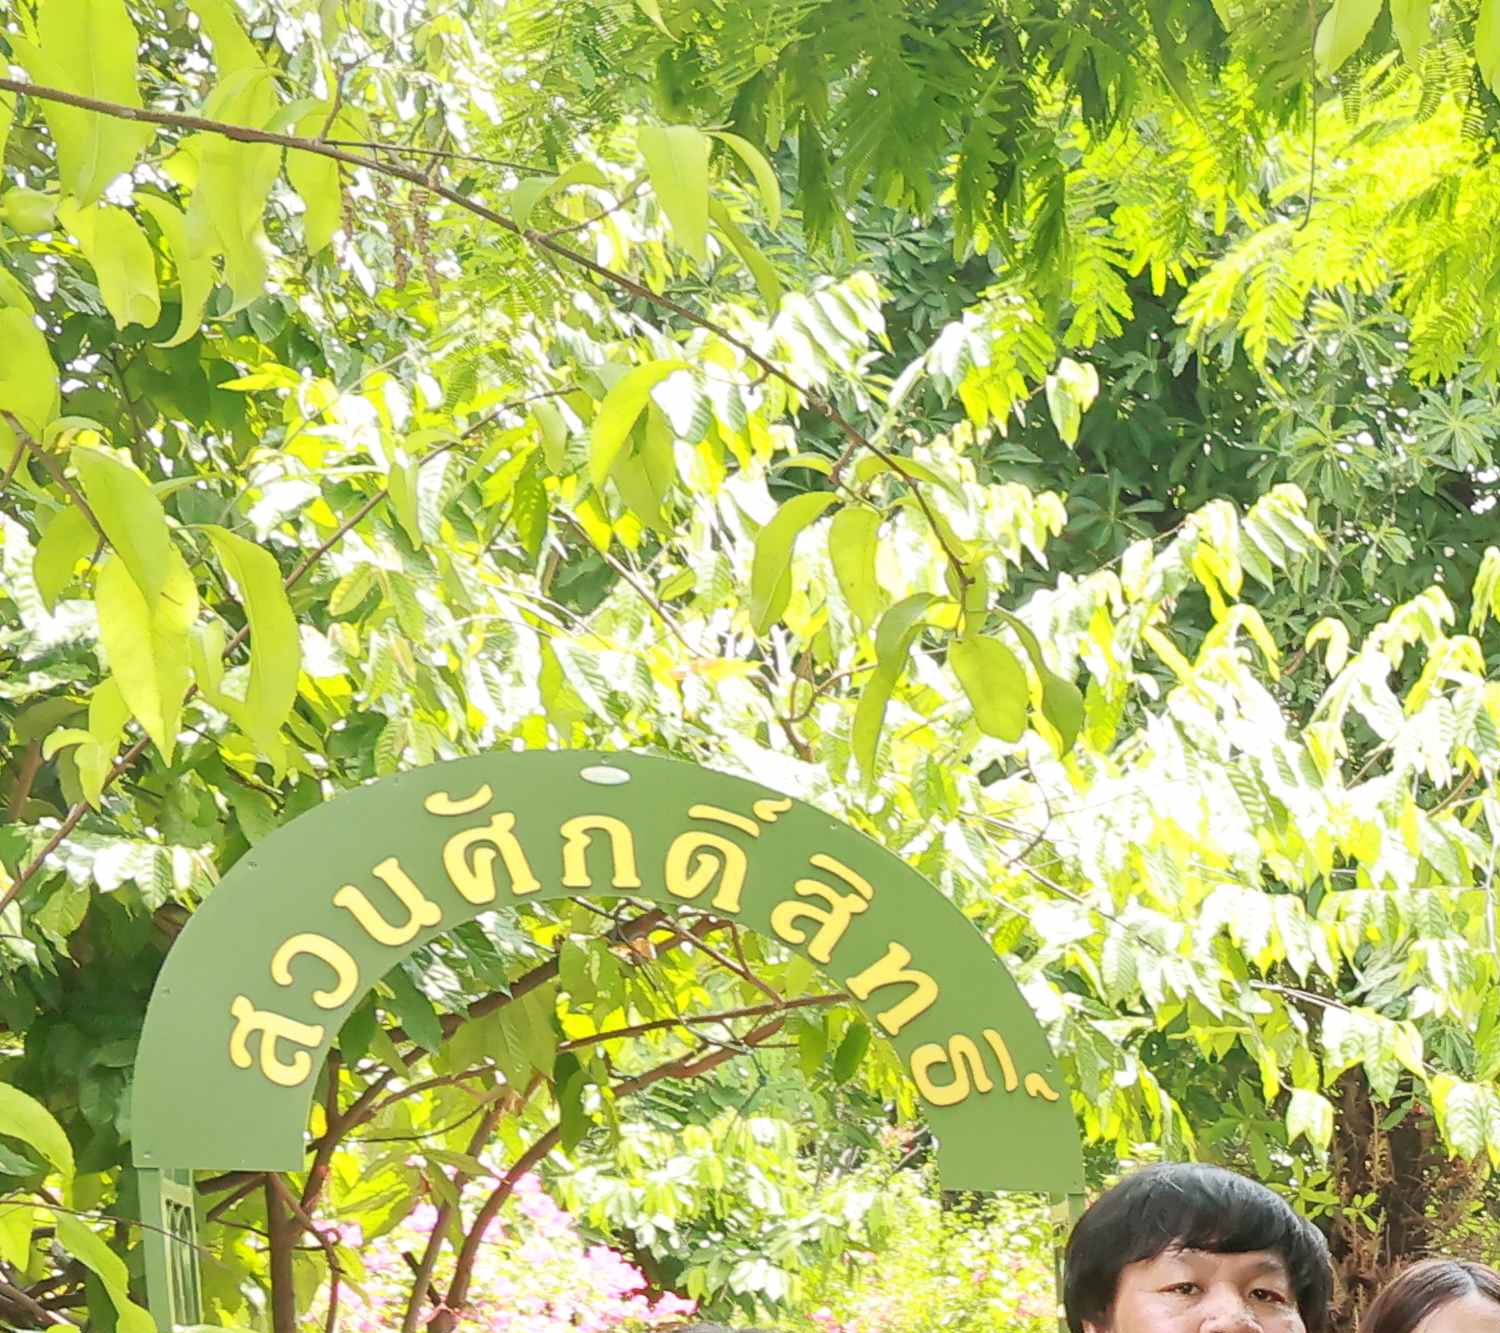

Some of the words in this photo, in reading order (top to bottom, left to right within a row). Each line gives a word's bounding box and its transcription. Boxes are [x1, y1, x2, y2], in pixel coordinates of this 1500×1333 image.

[228, 783, 1061, 1107] สวนศักดิ์สิทธิ์
